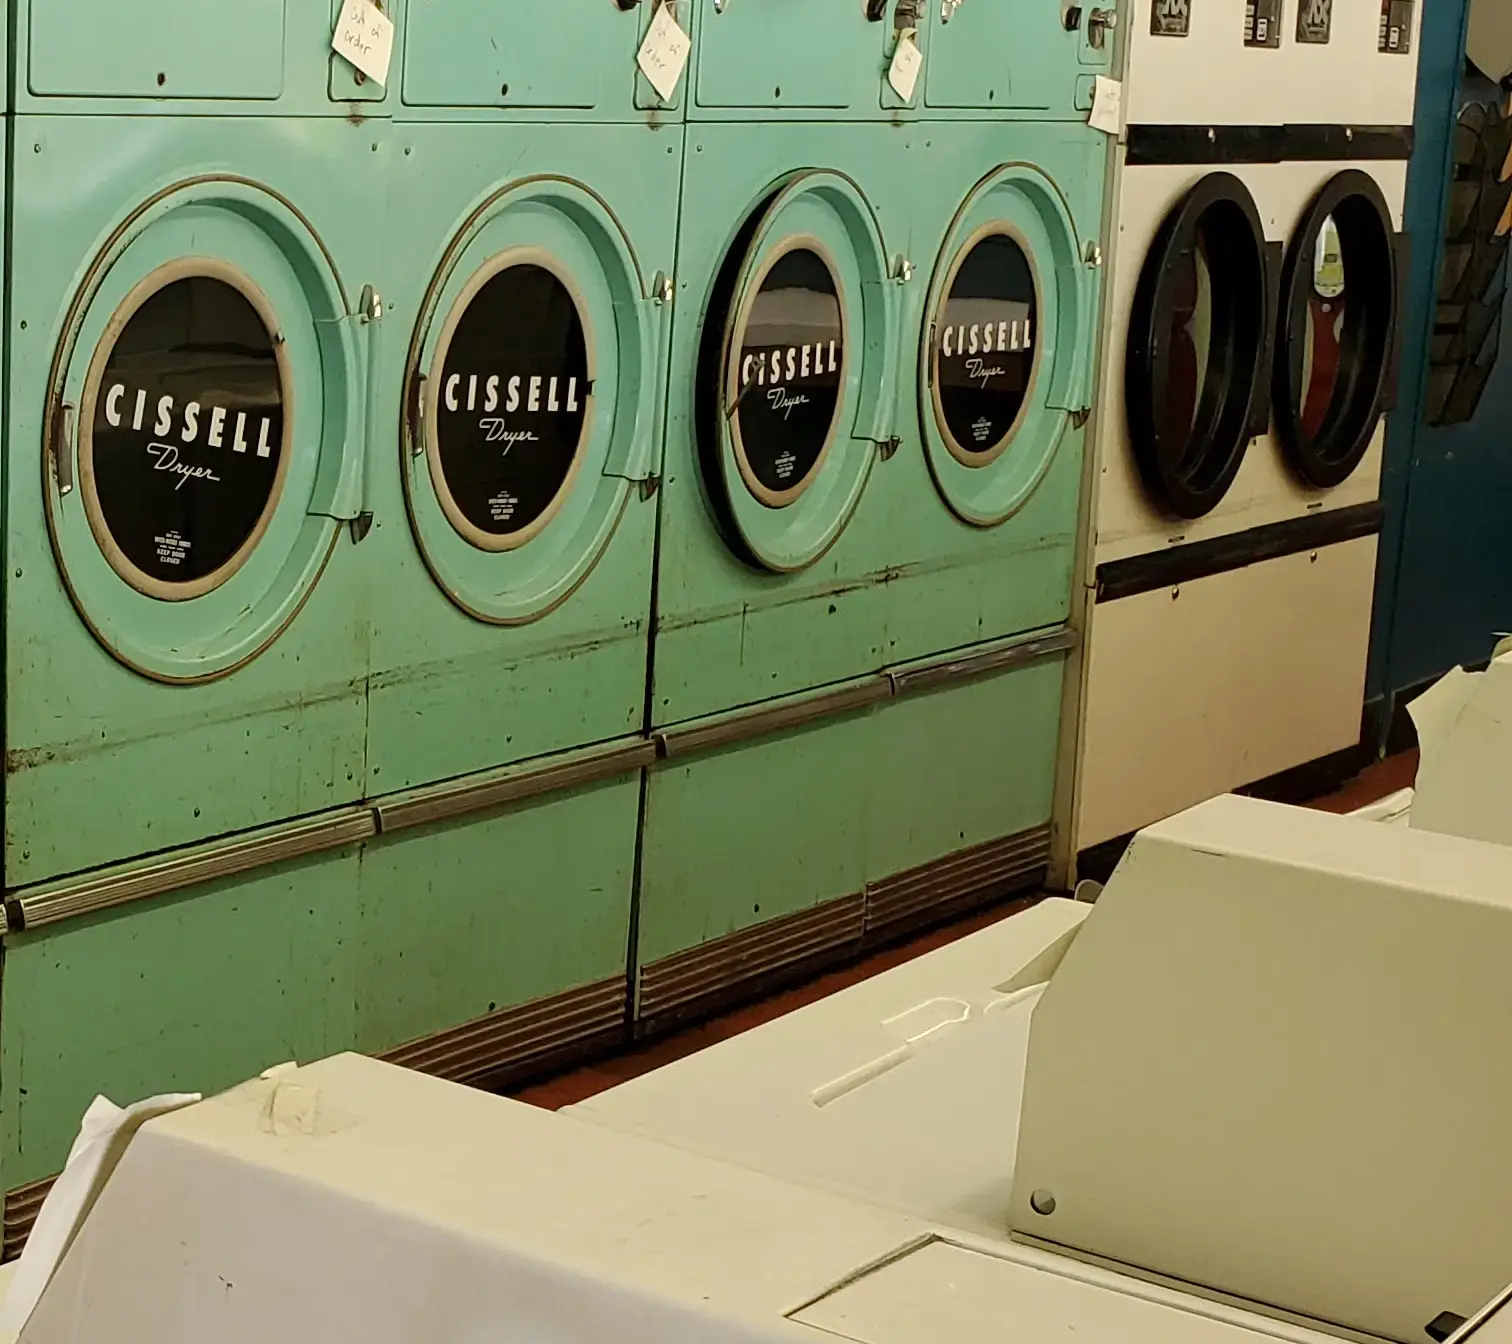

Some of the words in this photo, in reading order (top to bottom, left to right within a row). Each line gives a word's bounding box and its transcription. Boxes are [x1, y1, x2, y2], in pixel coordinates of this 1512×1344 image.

[943, 320, 1031, 357] CISSELL
[445, 373, 578, 412] CISSELL
[965, 358, 1005, 389] Dryer
[105, 383, 271, 458] CISSELL
[767, 387, 810, 421] Dryer
[479, 418, 539, 456] Dryer
[146, 442, 221, 491] Dryer
